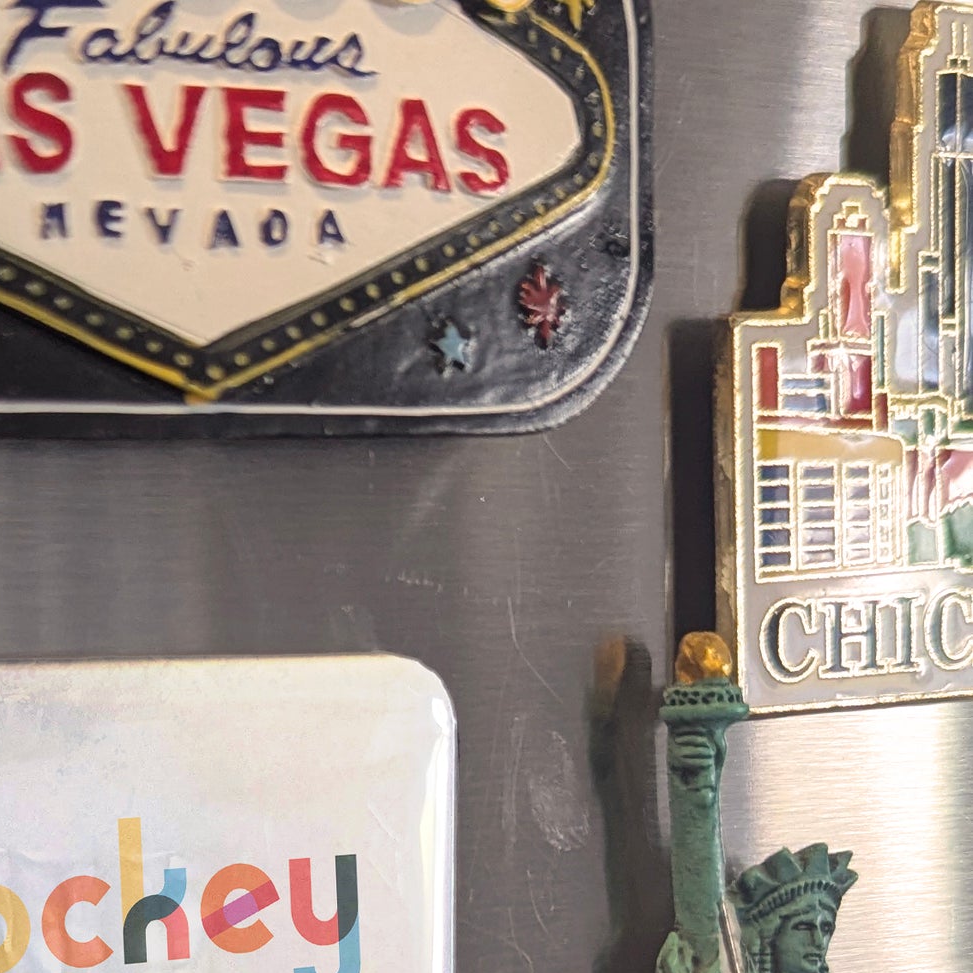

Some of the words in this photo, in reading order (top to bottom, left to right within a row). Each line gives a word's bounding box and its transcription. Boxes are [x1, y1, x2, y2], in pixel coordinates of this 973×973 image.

[3, 0, 378, 77] Fabulous
[123, 83, 511, 195] VEGAS
[39, 200, 346, 249] NEVADA
[760, 588, 973, 683] CHIC
